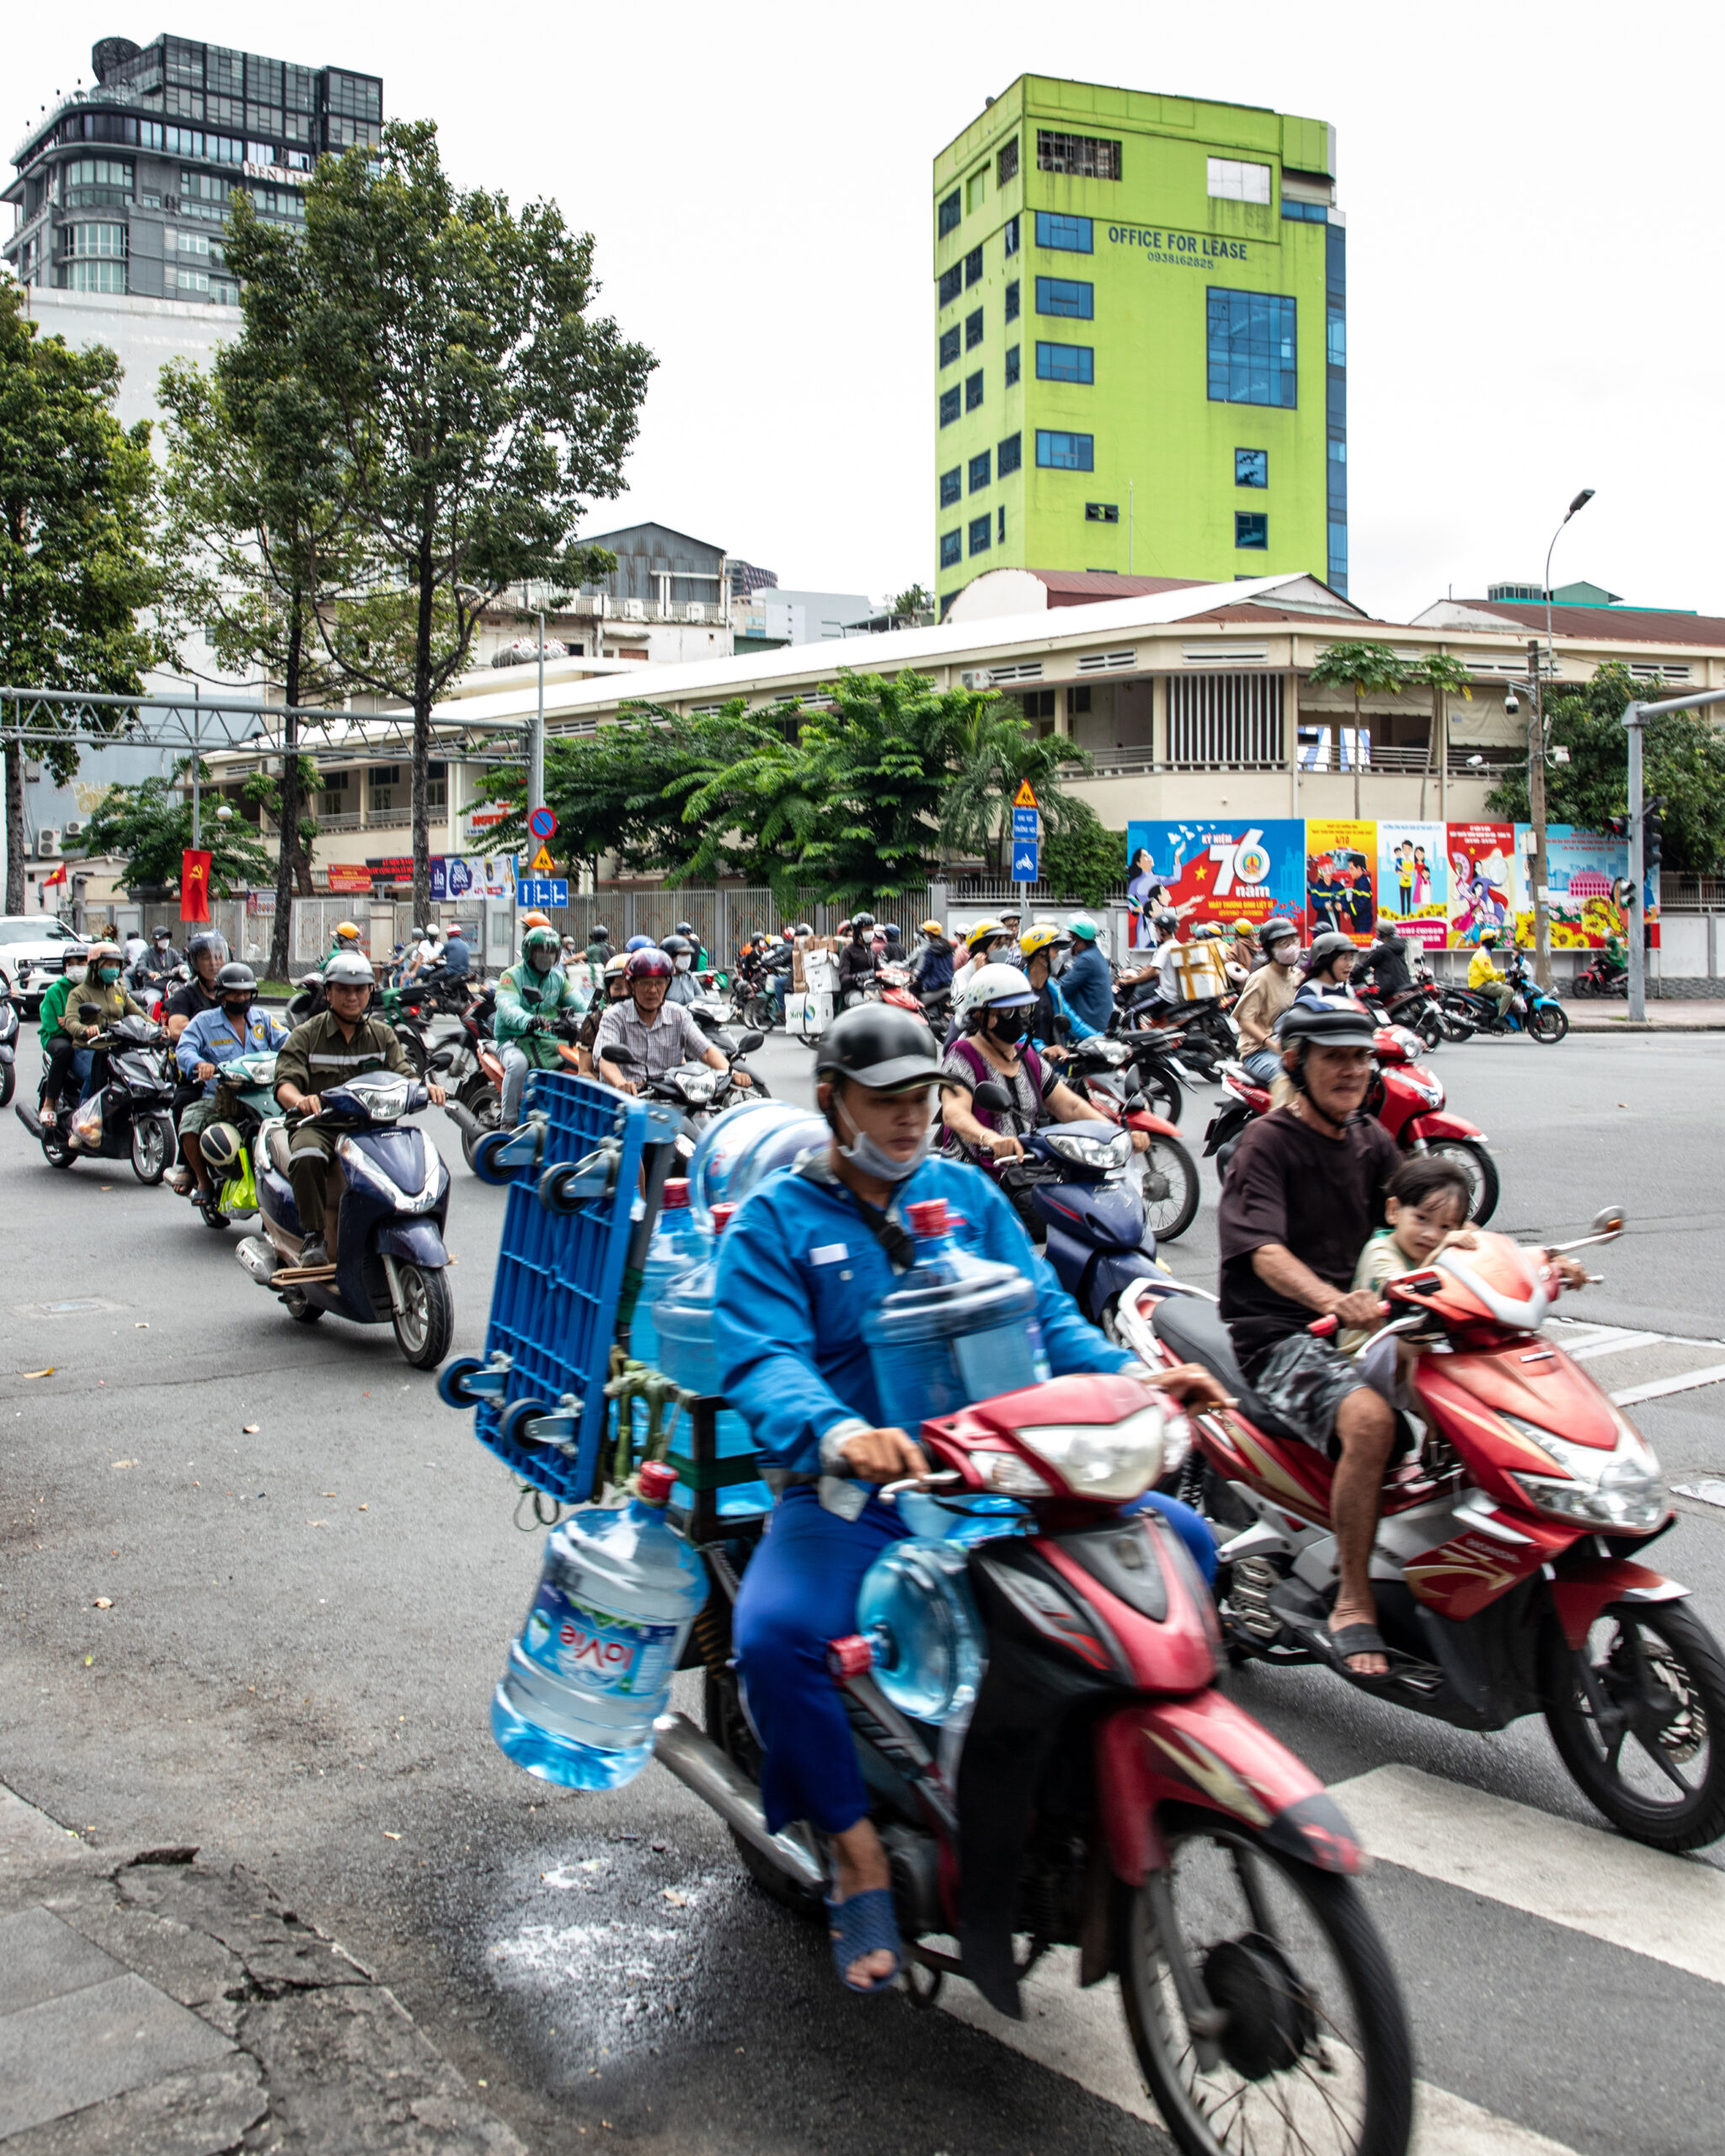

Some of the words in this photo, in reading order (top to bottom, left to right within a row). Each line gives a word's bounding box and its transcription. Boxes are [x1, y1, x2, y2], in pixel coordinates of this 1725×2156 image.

[1108, 226, 1162, 248] OFFICE
[1167, 233, 1197, 253] FOR
[1202, 238, 1247, 260] LEASE
[1147, 252, 1214, 270] 0938162825
[1209, 828, 1270, 896] 76
[433, 868, 445, 886] ila
[1236, 884, 1270, 898] năm
